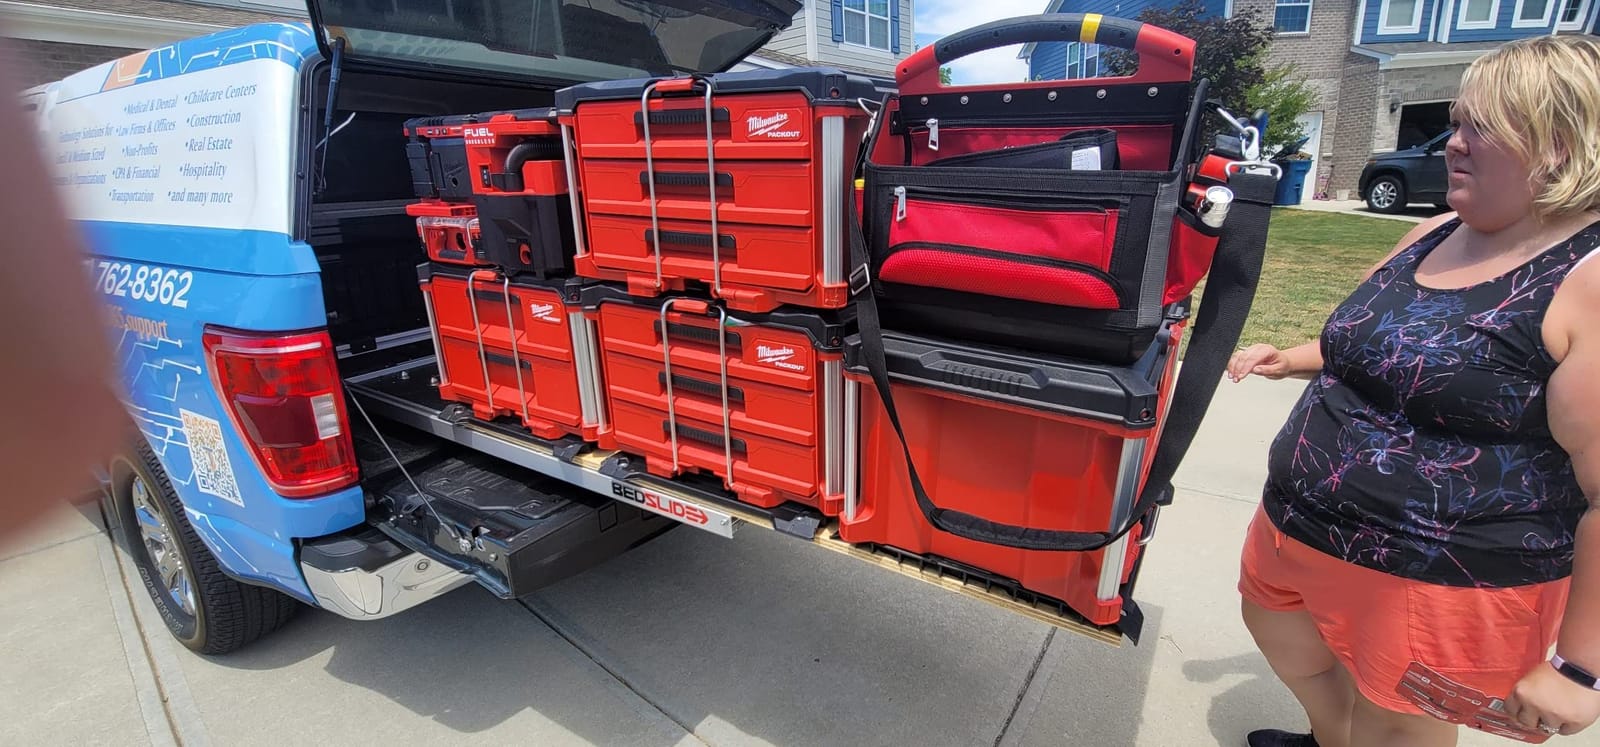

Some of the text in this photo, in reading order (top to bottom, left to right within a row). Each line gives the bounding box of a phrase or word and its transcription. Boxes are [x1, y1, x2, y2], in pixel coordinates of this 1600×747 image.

[187, 84, 257, 104] Childcare Centers
[127, 98, 150, 114] Medical
[155, 94, 179, 111] Dental
[153, 118, 177, 133] Offices
[190, 109, 242, 128] Construction
[747, 112, 788, 133] Milwaukee
[464, 127, 494, 138] FUEL
[188, 136, 233, 152] Real Estate
[132, 164, 161, 180] Financial
[182, 161, 227, 181] Hospitality
[171, 187, 234, 207] and many more
[756, 345, 795, 359] Milwaukee
